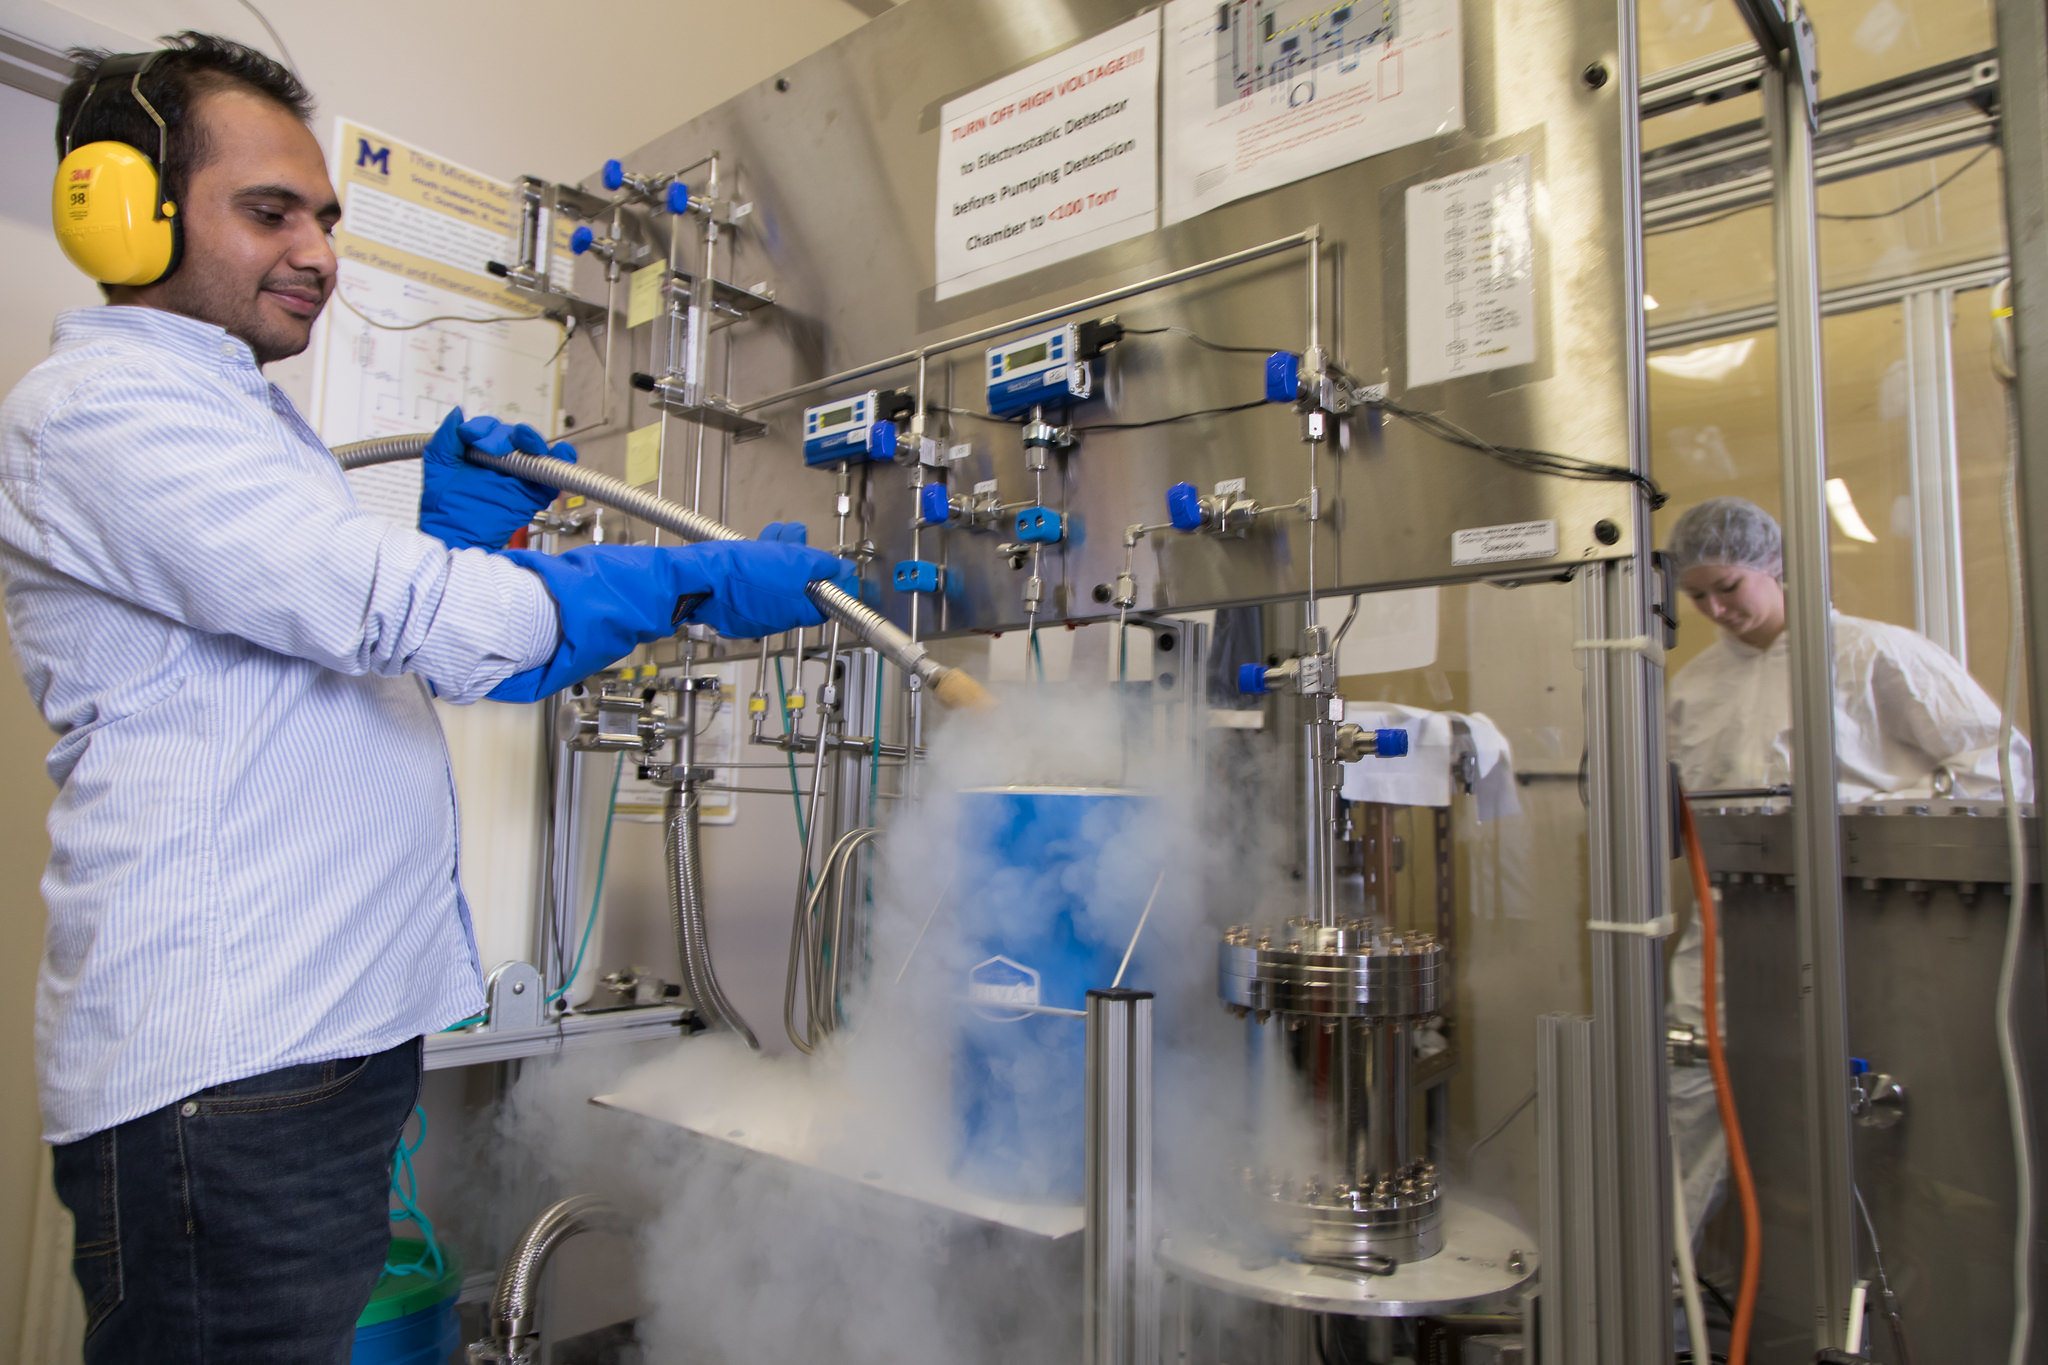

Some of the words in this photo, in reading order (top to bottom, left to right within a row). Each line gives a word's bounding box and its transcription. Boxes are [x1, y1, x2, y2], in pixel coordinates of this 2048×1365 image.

[952, 117, 986, 142] TURN
[989, 104, 1015, 126] OFF
[1018, 89, 1055, 115] HIGH
[1057, 47, 1146, 97] VOLTAGE!!!
[355, 138, 390, 176] M
[960, 161, 975, 175] to
[977, 126, 1062, 170] Electrostatic
[1064, 98, 1130, 136] Detector
[70, 168, 91, 182] 3M
[70, 192, 86, 206] 98
[953, 191, 998, 217] before
[1000, 167, 1061, 201] Pumping
[1064, 138, 1136, 177] Detection
[966, 221, 1027, 251] Chamber
[1030, 213, 1046, 230] to
[1047, 198, 1085, 222] <100
[1087, 187, 1120, 209] Torr
